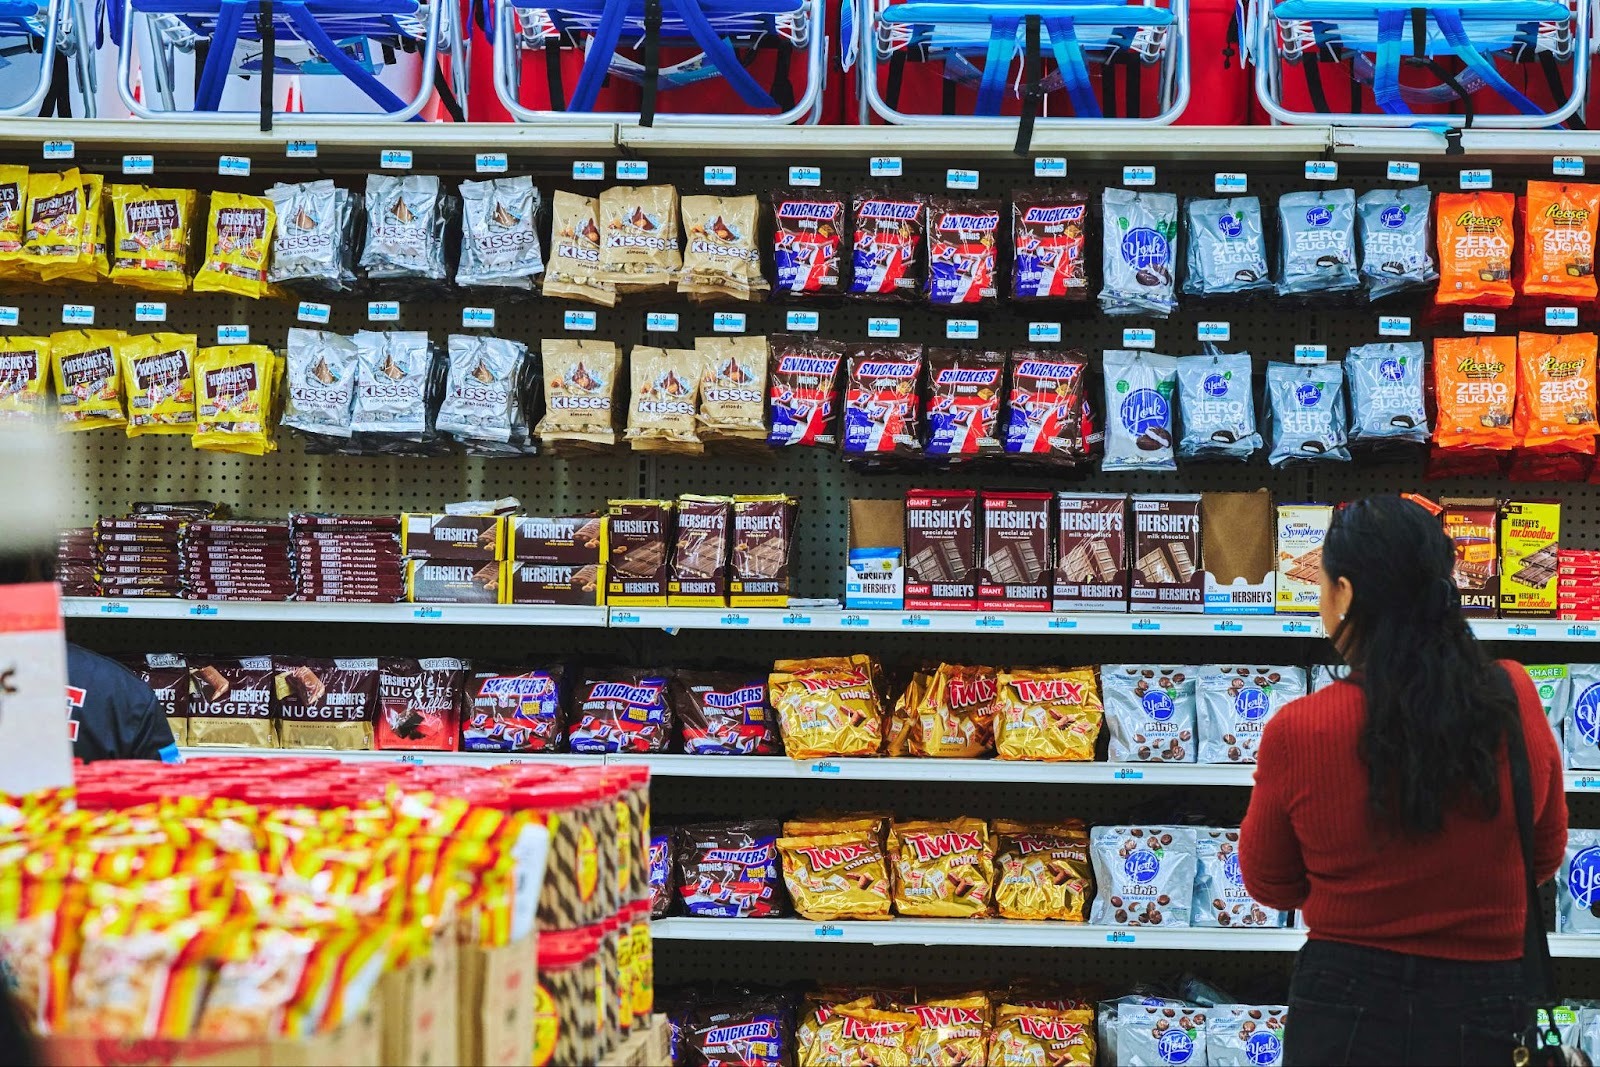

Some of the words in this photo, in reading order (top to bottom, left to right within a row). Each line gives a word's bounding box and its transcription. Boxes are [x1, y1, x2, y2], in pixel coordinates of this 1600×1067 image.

[781, 204, 836, 218] SNICKERS
[862, 204, 919, 219] SNICKERS
[1028, 207, 1081, 221] SNICKERS
[1546, 204, 1590, 220] Reese's
[941, 215, 998, 230] SNICKERS
[1456, 212, 1503, 227] Reese's
[1296, 231, 1347, 241] ZERO
[1369, 233, 1416, 246] ZERO
[1455, 236, 1506, 248] ZERO
[1544, 229, 1592, 242] ZERO
[1213, 242, 1258, 254] ZERO
[1296, 241, 1349, 251] SUGAR
[1365, 243, 1415, 255] SUGAR
[1544, 241, 1591, 254] SUGAR
[1123, 239, 1167, 270] York
[1214, 253, 1260, 265] SUGAR
[1455, 248, 1506, 258] SUGAR
[781, 357, 837, 373] SNICKERS
[859, 363, 915, 377] SNICKERS
[1020, 362, 1077, 378] SNICKERS
[1458, 357, 1505, 373] Reese's
[1542, 357, 1586, 372] Reese's
[939, 370, 996, 383] SNICKERS
[956, 385, 978, 393] MINIS
[1371, 384, 1421, 399] ZERO
[1456, 382, 1507, 395] ZERO
[1539, 379, 1589, 393] ZERO
[1371, 398, 1421, 410] SUGAR
[1456, 394, 1507, 404] SUGAR
[1539, 392, 1587, 403] SUGAR
[1192, 401, 1244, 414] ZERO
[1122, 401, 1167, 436] York
[1191, 413, 1245, 425] SUGAR
[1283, 411, 1332, 424] ZERO
[1282, 424, 1332, 434] SUGAR
[679, 514, 724, 530] HERSHEY'S
[736, 515, 780, 531] HERSHEY'S
[910, 510, 972, 529] HERSHEY'S
[985, 511, 1047, 530] HERSHEY'S
[1060, 512, 1122, 531] HERSHEY'S
[1139, 514, 1199, 532] HERSHEY'S
[1512, 519, 1540, 528] HERSHEY'S
[523, 523, 575, 539] HERSHEY'S
[614, 520, 659, 534] HERSHEY'S
[1280, 524, 1326, 543] Symphony
[1450, 525, 1493, 538] HEATH
[434, 527, 478, 543] HERSHEY'S
[423, 565, 473, 582] HERSHEY'S
[521, 567, 572, 583] HERSHEY'S
[625, 583, 659, 594] HERSHEY'S
[681, 583, 716, 594] HERSHEY'S
[744, 582, 779, 593] HERSHEY'S
[862, 583, 897, 594] HERSHEY'S
[932, 584, 974, 598] HERSHEY'S
[1006, 585, 1047, 599] HERSHEY'S
[1081, 585, 1123, 598] HERSHEY'S
[1158, 588, 1200, 601] HERSHEY'S
[1232, 591, 1272, 603] HERSHEY'S
[381, 675, 415, 687] HERSHEY'S
[482, 678, 546, 696] SNICKERS
[230, 690, 270, 703] HERSHEY'S
[380, 687, 452, 697] NUGGETS
[591, 685, 655, 703] SNICKERS
[706, 688, 762, 707] SNICKERS
[840, 691, 871, 701] minis
[326, 693, 365, 705] HERSHEY'S
[189, 702, 270, 715] NUGGETS
[283, 705, 365, 718] NUGGETS
[1143, 698, 1172, 719] York
[1145, 722, 1179, 731] minis
[709, 848, 767, 862] SNICKERS
[1052, 850, 1086, 860] minis
[1122, 885, 1157, 895] minis
[709, 1024, 769, 1042] SNICKERS
[947, 1029, 980, 1039] minis
[703, 1046, 725, 1054] MINIS
[1050, 1037, 1084, 1050] minis
[1246, 1036, 1280, 1060] York
